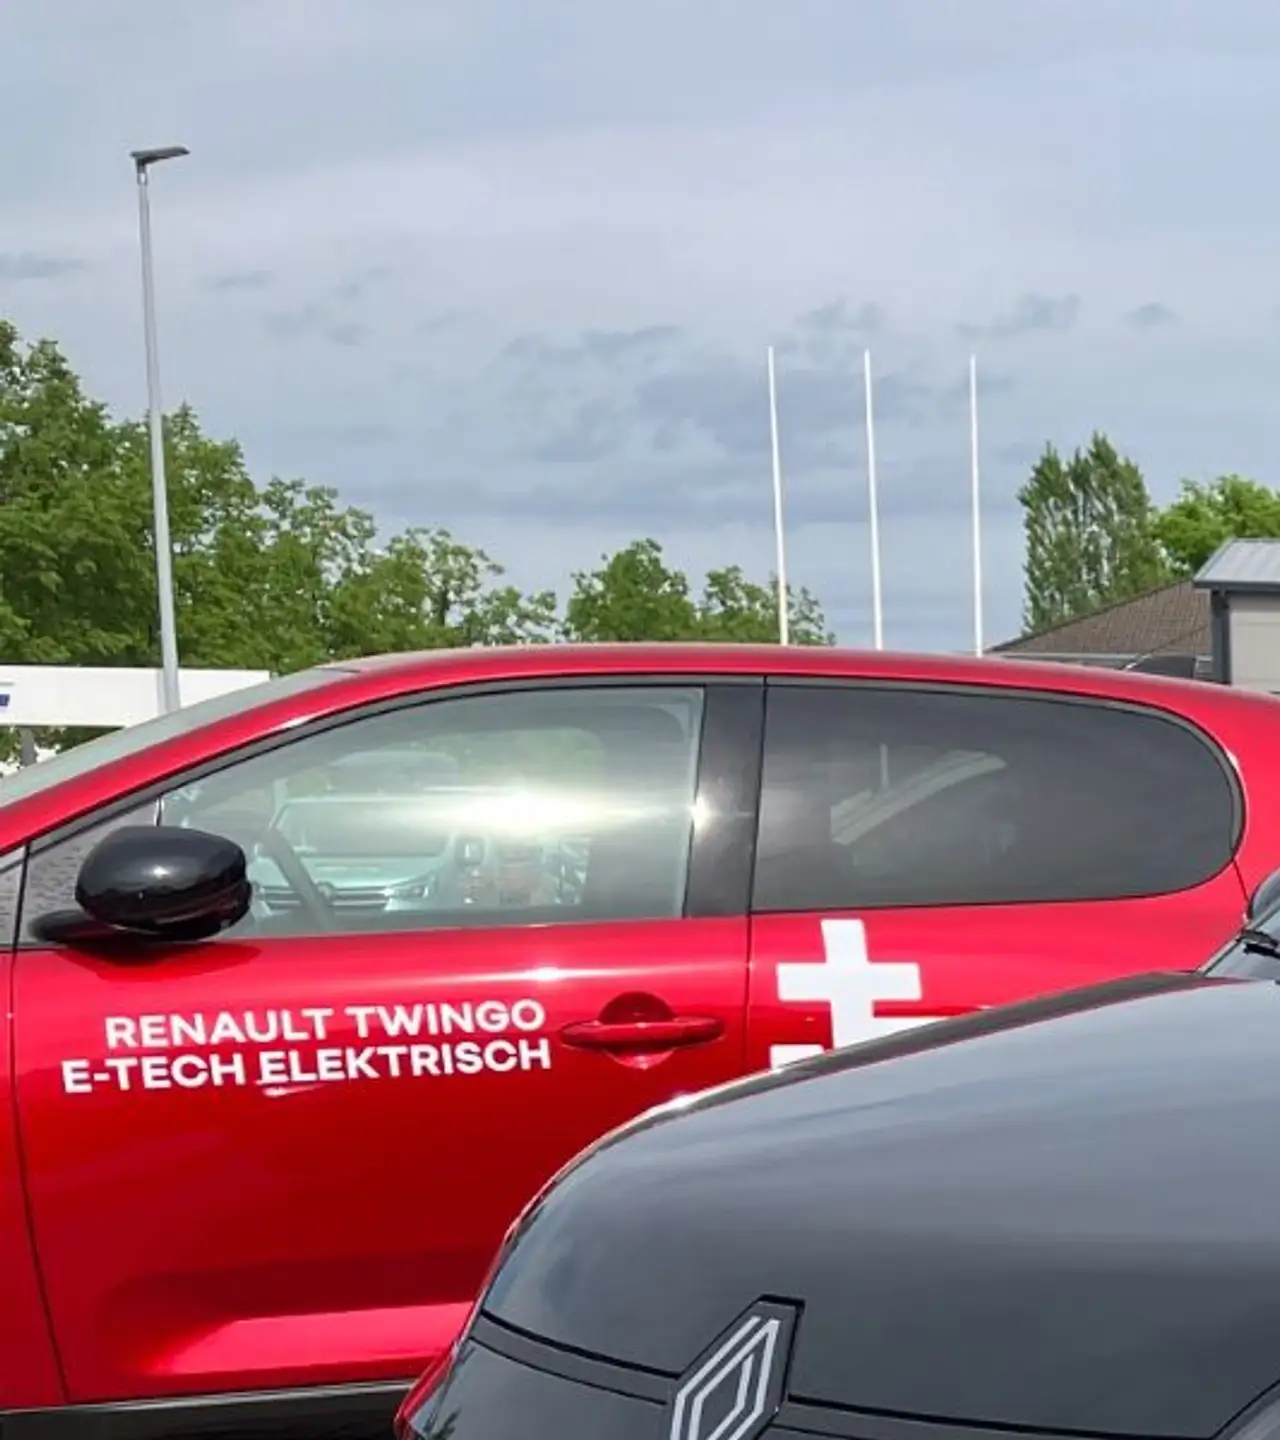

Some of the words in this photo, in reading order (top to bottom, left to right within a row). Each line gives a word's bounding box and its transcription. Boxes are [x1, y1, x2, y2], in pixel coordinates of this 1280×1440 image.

[104, 1007, 334, 1049] RENAULT
[344, 998, 546, 1038] TWINGO
[61, 1052, 246, 1094] E-TECH
[256, 1038, 551, 1086] ELEKTRISCH
